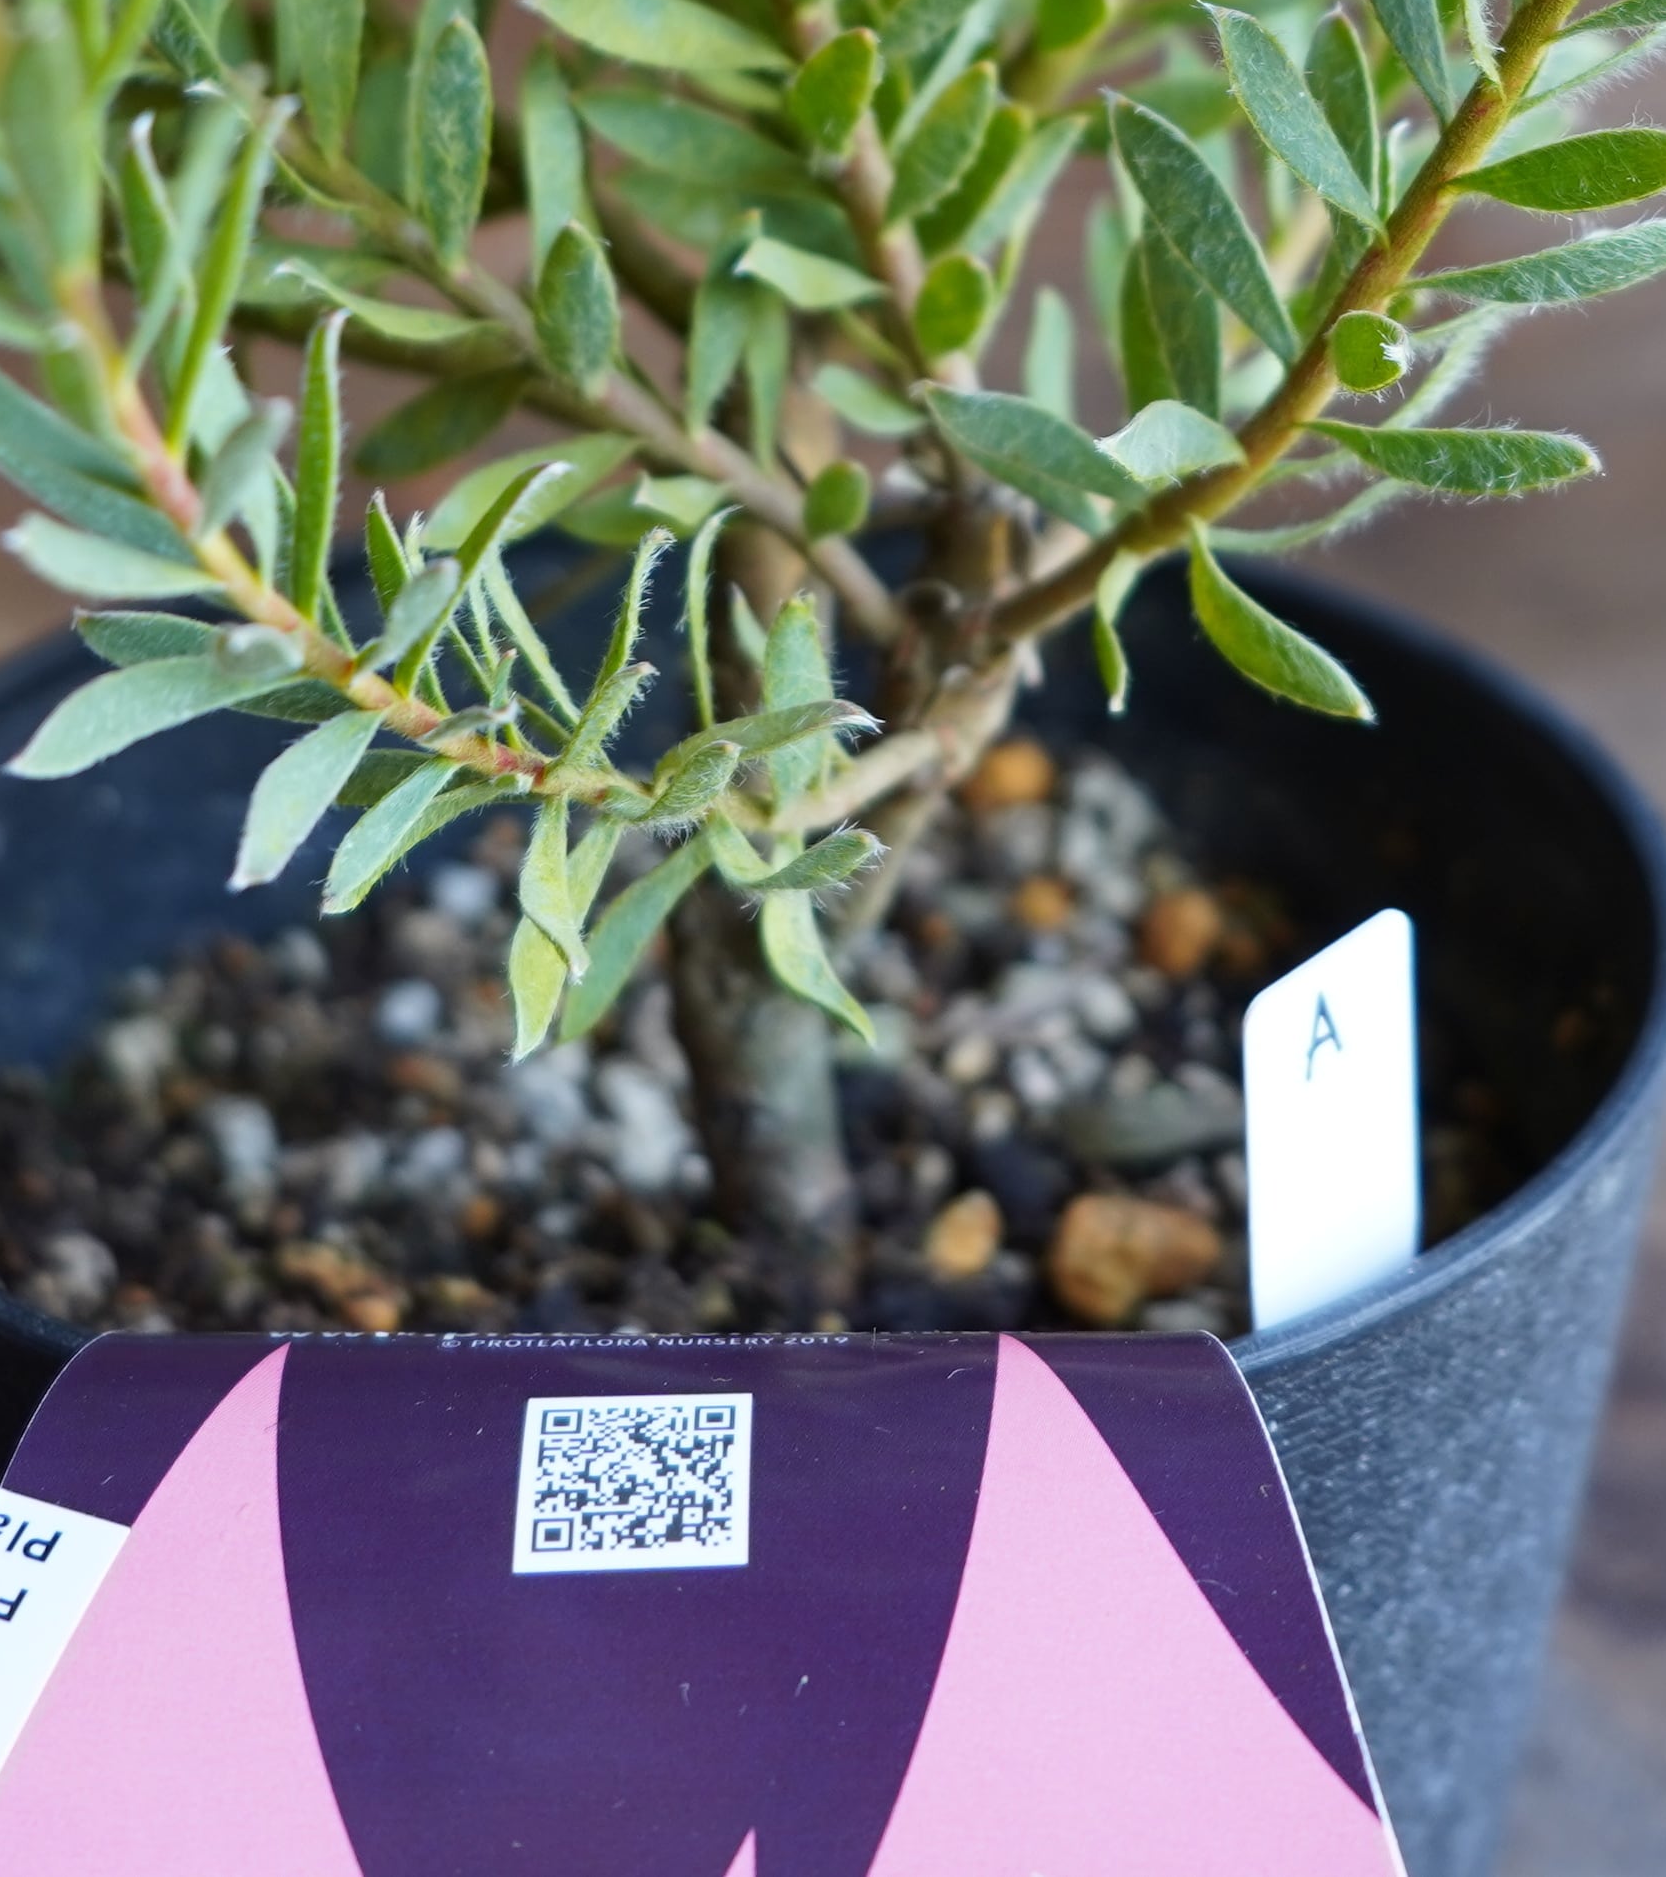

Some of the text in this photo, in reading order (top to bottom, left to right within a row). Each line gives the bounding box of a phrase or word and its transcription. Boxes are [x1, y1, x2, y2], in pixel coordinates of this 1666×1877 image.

[1305, 990, 1343, 1081] A
[470, 1338, 648, 1348] PROTEAFLORA
[657, 1336, 775, 1346] NURSERY
[783, 1336, 849, 1345] 2019
